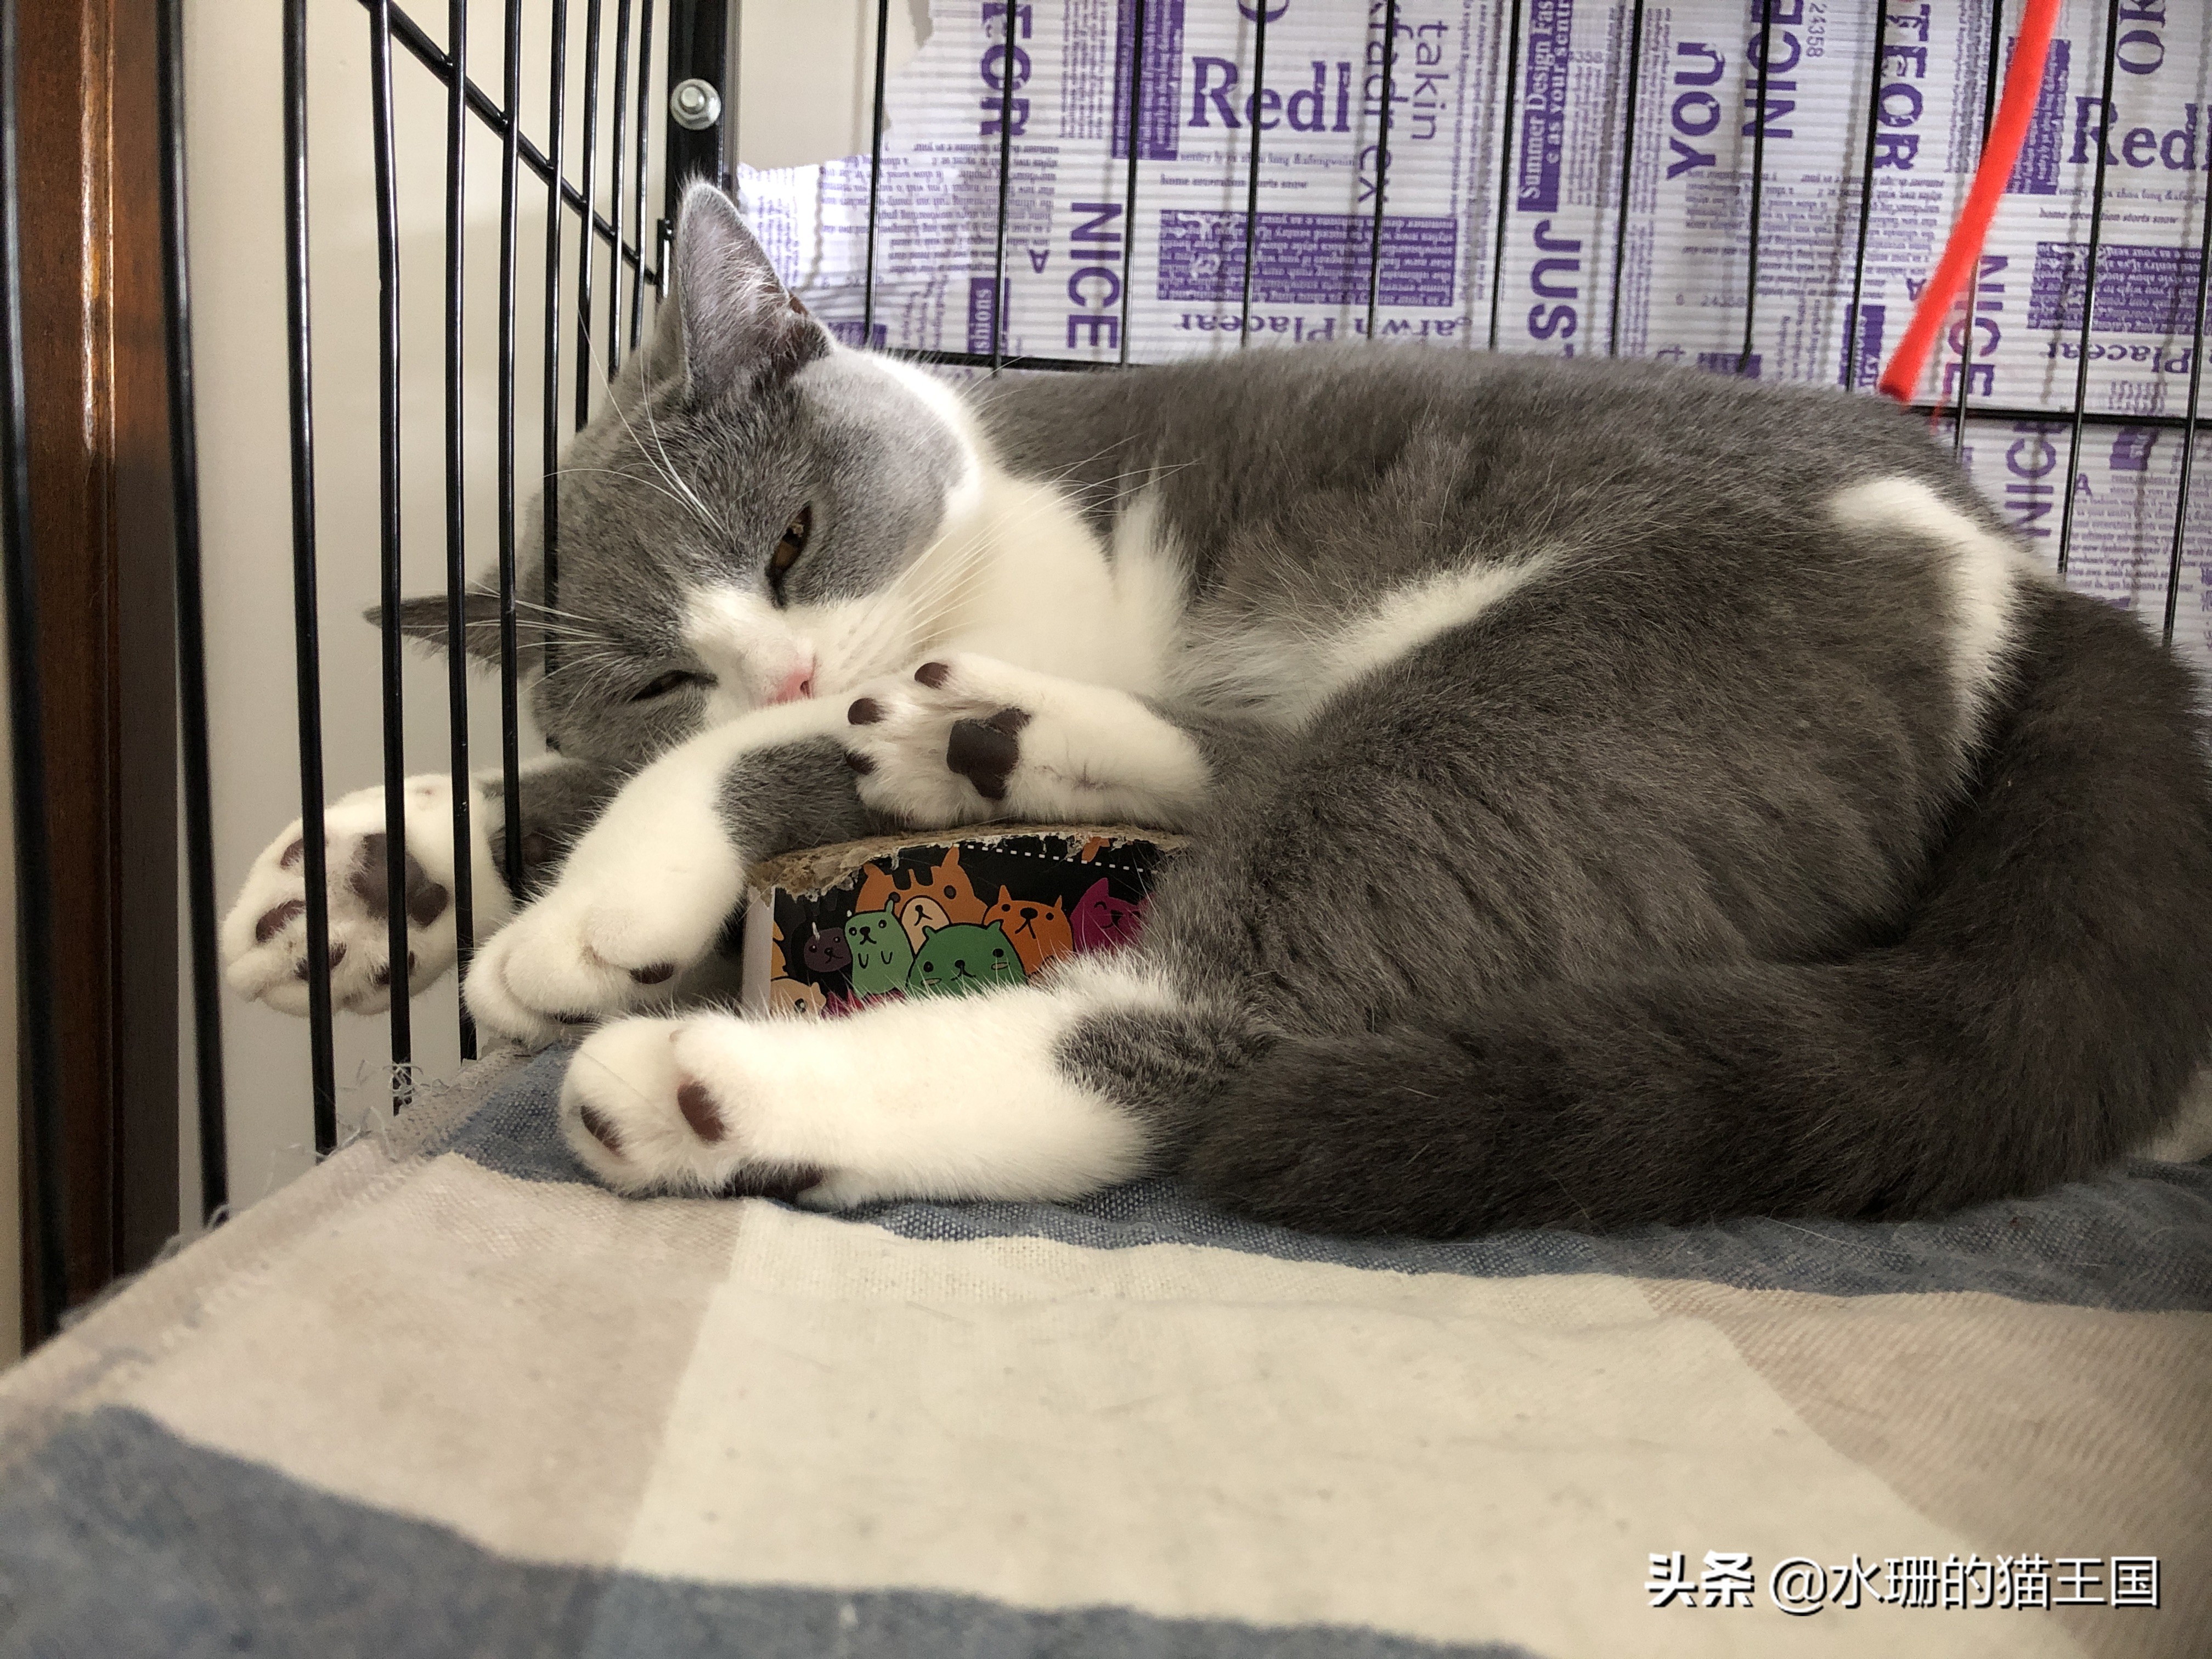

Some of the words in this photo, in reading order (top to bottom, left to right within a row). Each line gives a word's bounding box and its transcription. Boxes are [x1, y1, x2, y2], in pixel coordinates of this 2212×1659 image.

[1188, 57, 1351, 132] Redl
[1410, 20, 1450, 142] takin
[1526, 40, 1555, 110] Design
[1550, 62, 1567, 114] your
[1666, 42, 1725, 180] YOU
[1742, 0, 1803, 139] NICE
[1520, 116, 1546, 199] Summer
[1027, 250, 1050, 274] A
[1067, 202, 1123, 349] NICE
[1528, 219, 1582, 358] JUS
